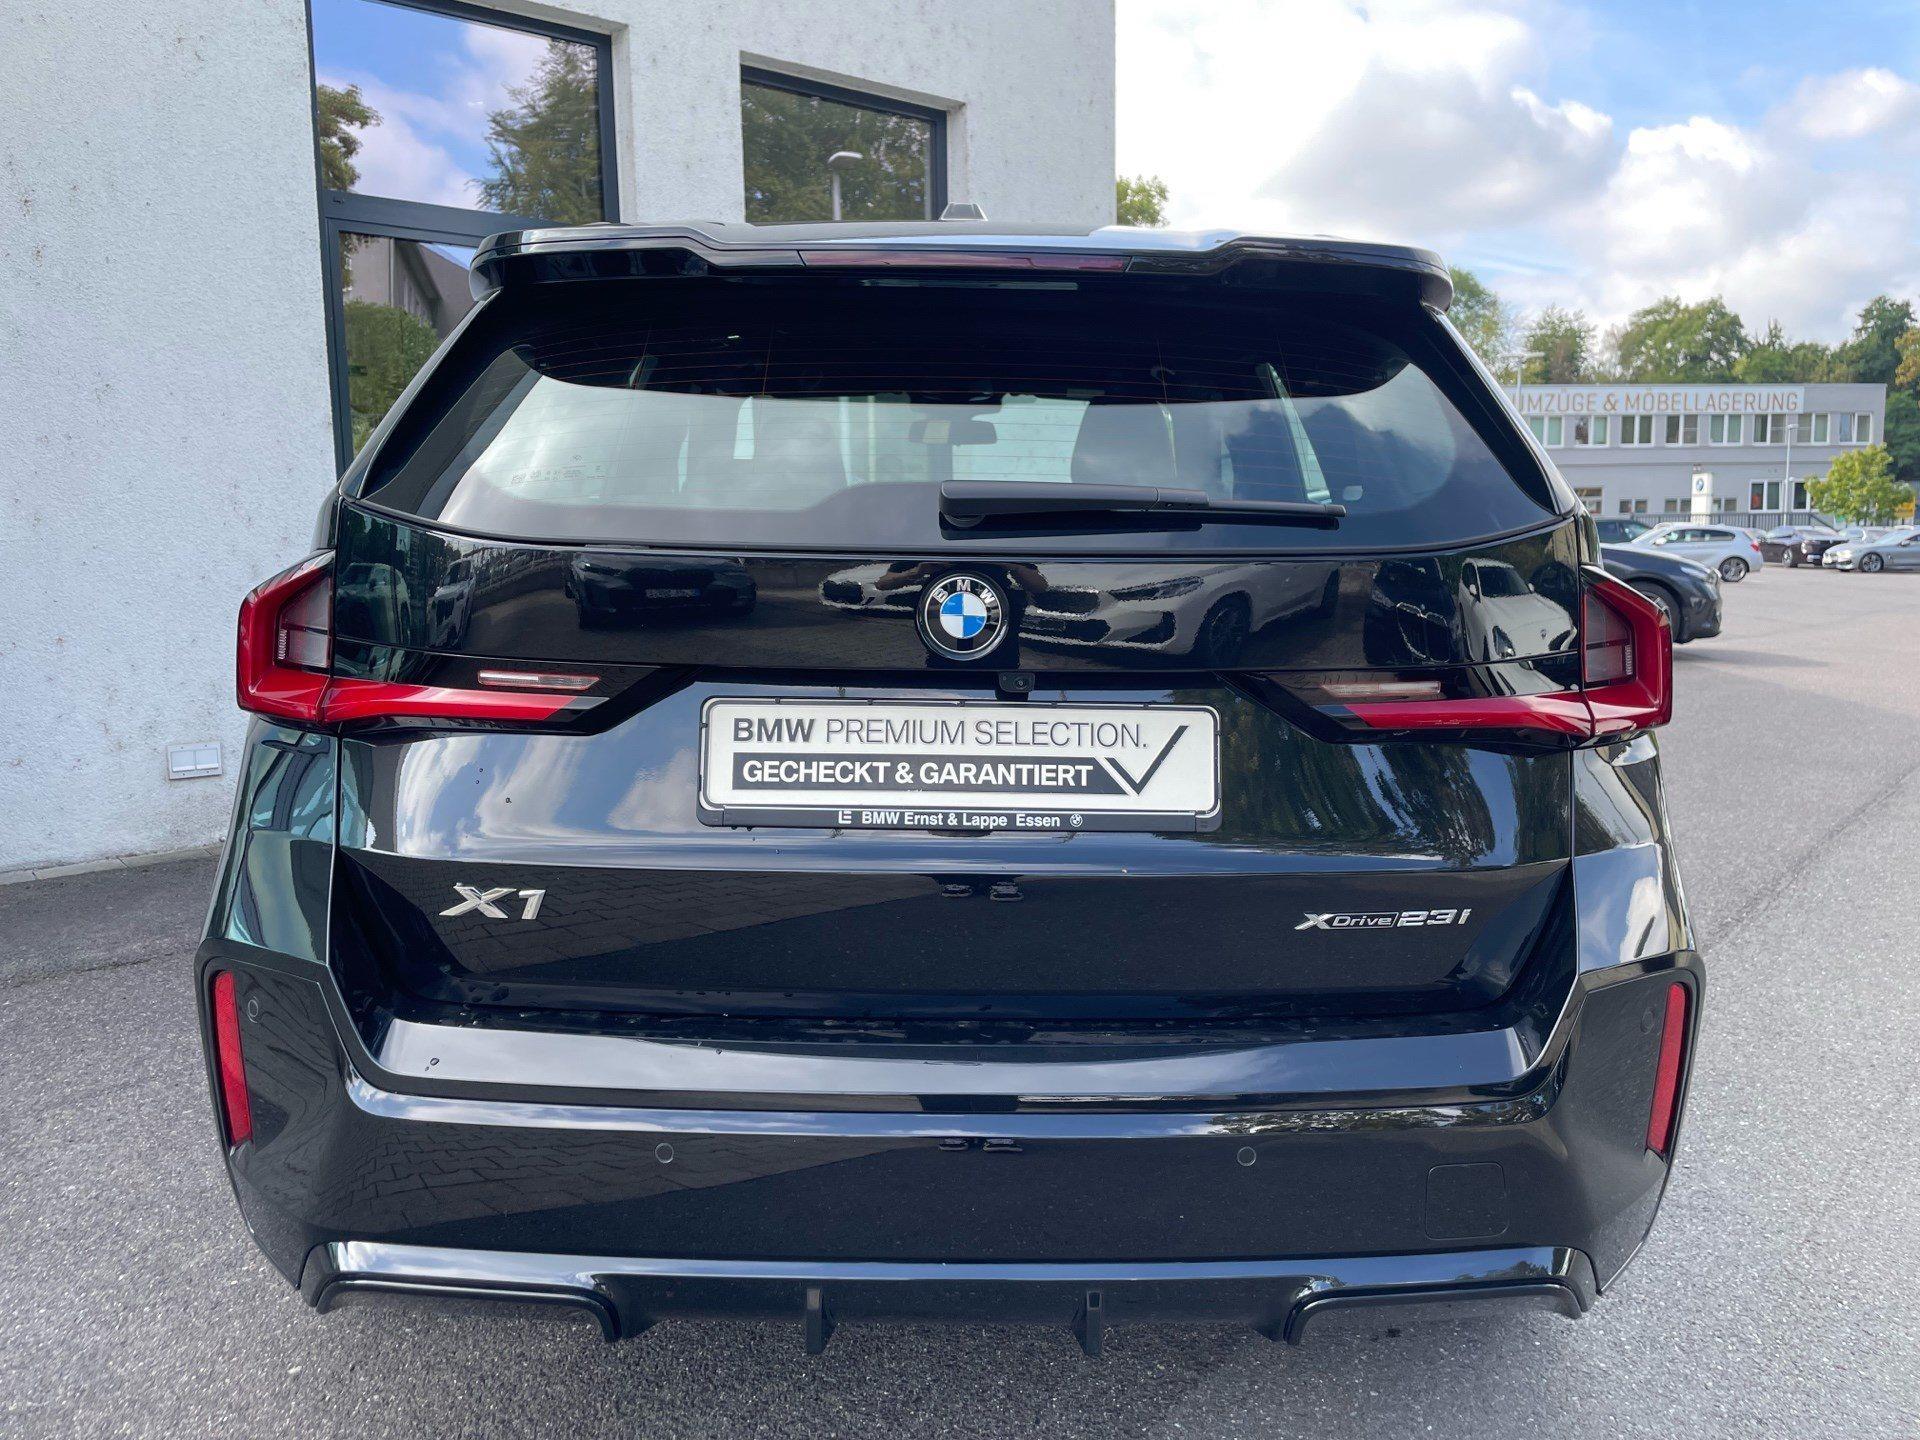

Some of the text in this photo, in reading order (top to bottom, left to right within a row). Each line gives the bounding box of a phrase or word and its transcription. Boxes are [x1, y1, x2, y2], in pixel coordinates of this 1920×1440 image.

[1604, 393, 1618, 411] &
[1625, 387, 1798, 412] MÖBELLAGERUNG
[932, 579, 996, 604] BMW
[733, 718, 1148, 748] BMW PREMIUM SELECTION.
[743, 760, 1093, 787] GECHECKT & GARANTIERT
[862, 811, 900, 825] BMW
[904, 812, 944, 826] Ernst
[947, 813, 958, 825] &
[962, 812, 1008, 829] Lappe
[1016, 813, 1061, 827] Essen
[438, 882, 546, 920] X1
